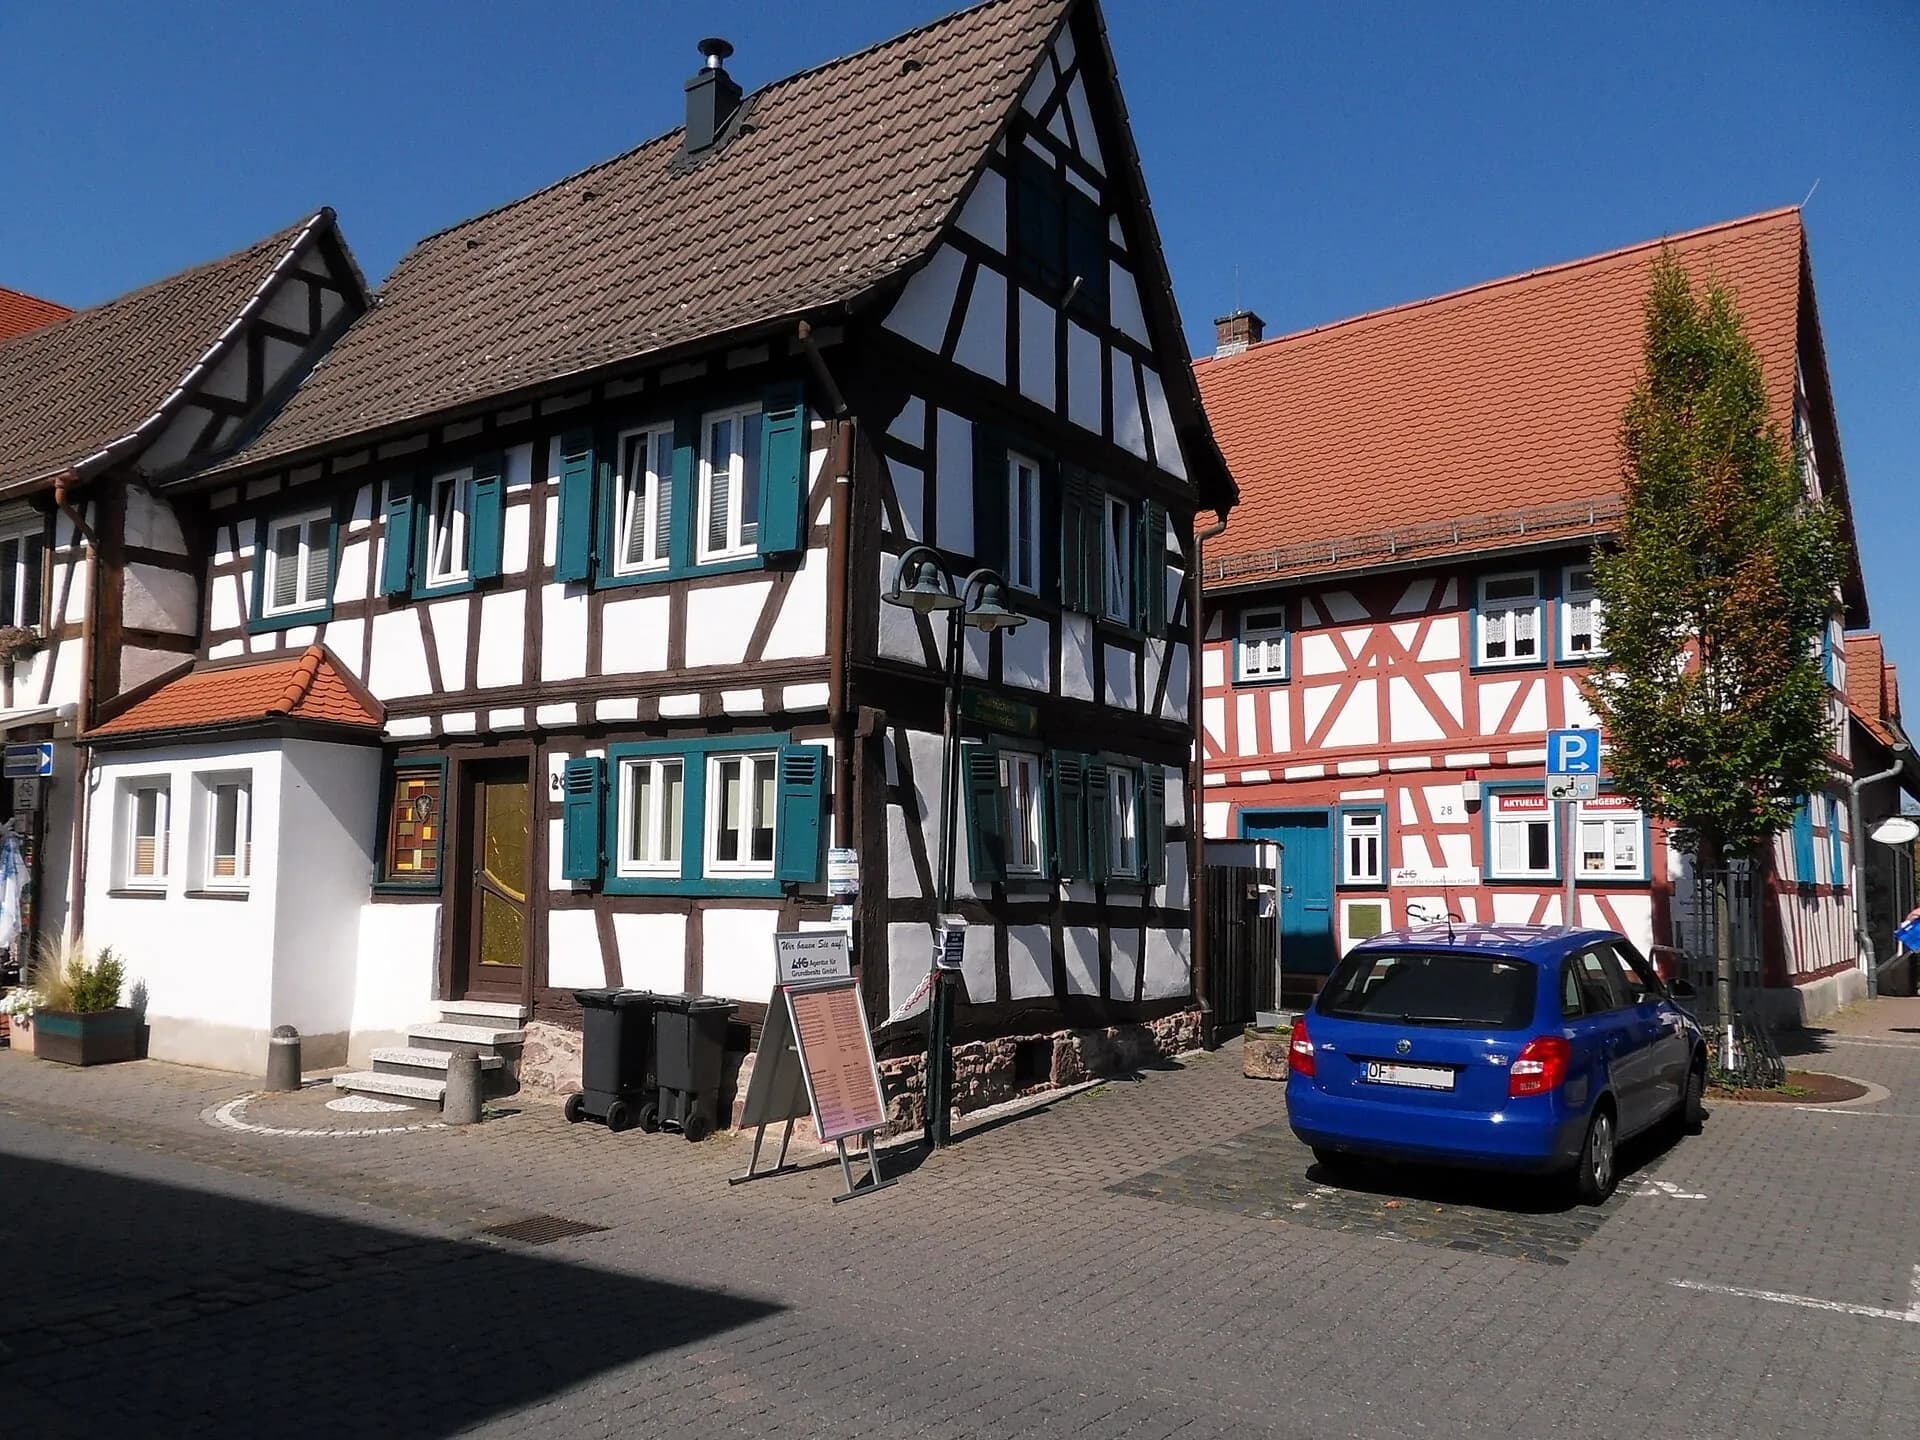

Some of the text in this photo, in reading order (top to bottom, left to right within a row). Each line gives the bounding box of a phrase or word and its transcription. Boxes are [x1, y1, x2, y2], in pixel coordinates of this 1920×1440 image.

[1559, 735, 1588, 772] P
[1503, 798, 1545, 808] AKTUELLE
[1440, 806, 1453, 815] 28
[781, 940, 795, 950] Wir
[818, 939, 829, 948] Sie
[791, 967, 838, 977] Grundbesitz GmbH
[1369, 1062, 1388, 1078] OF
